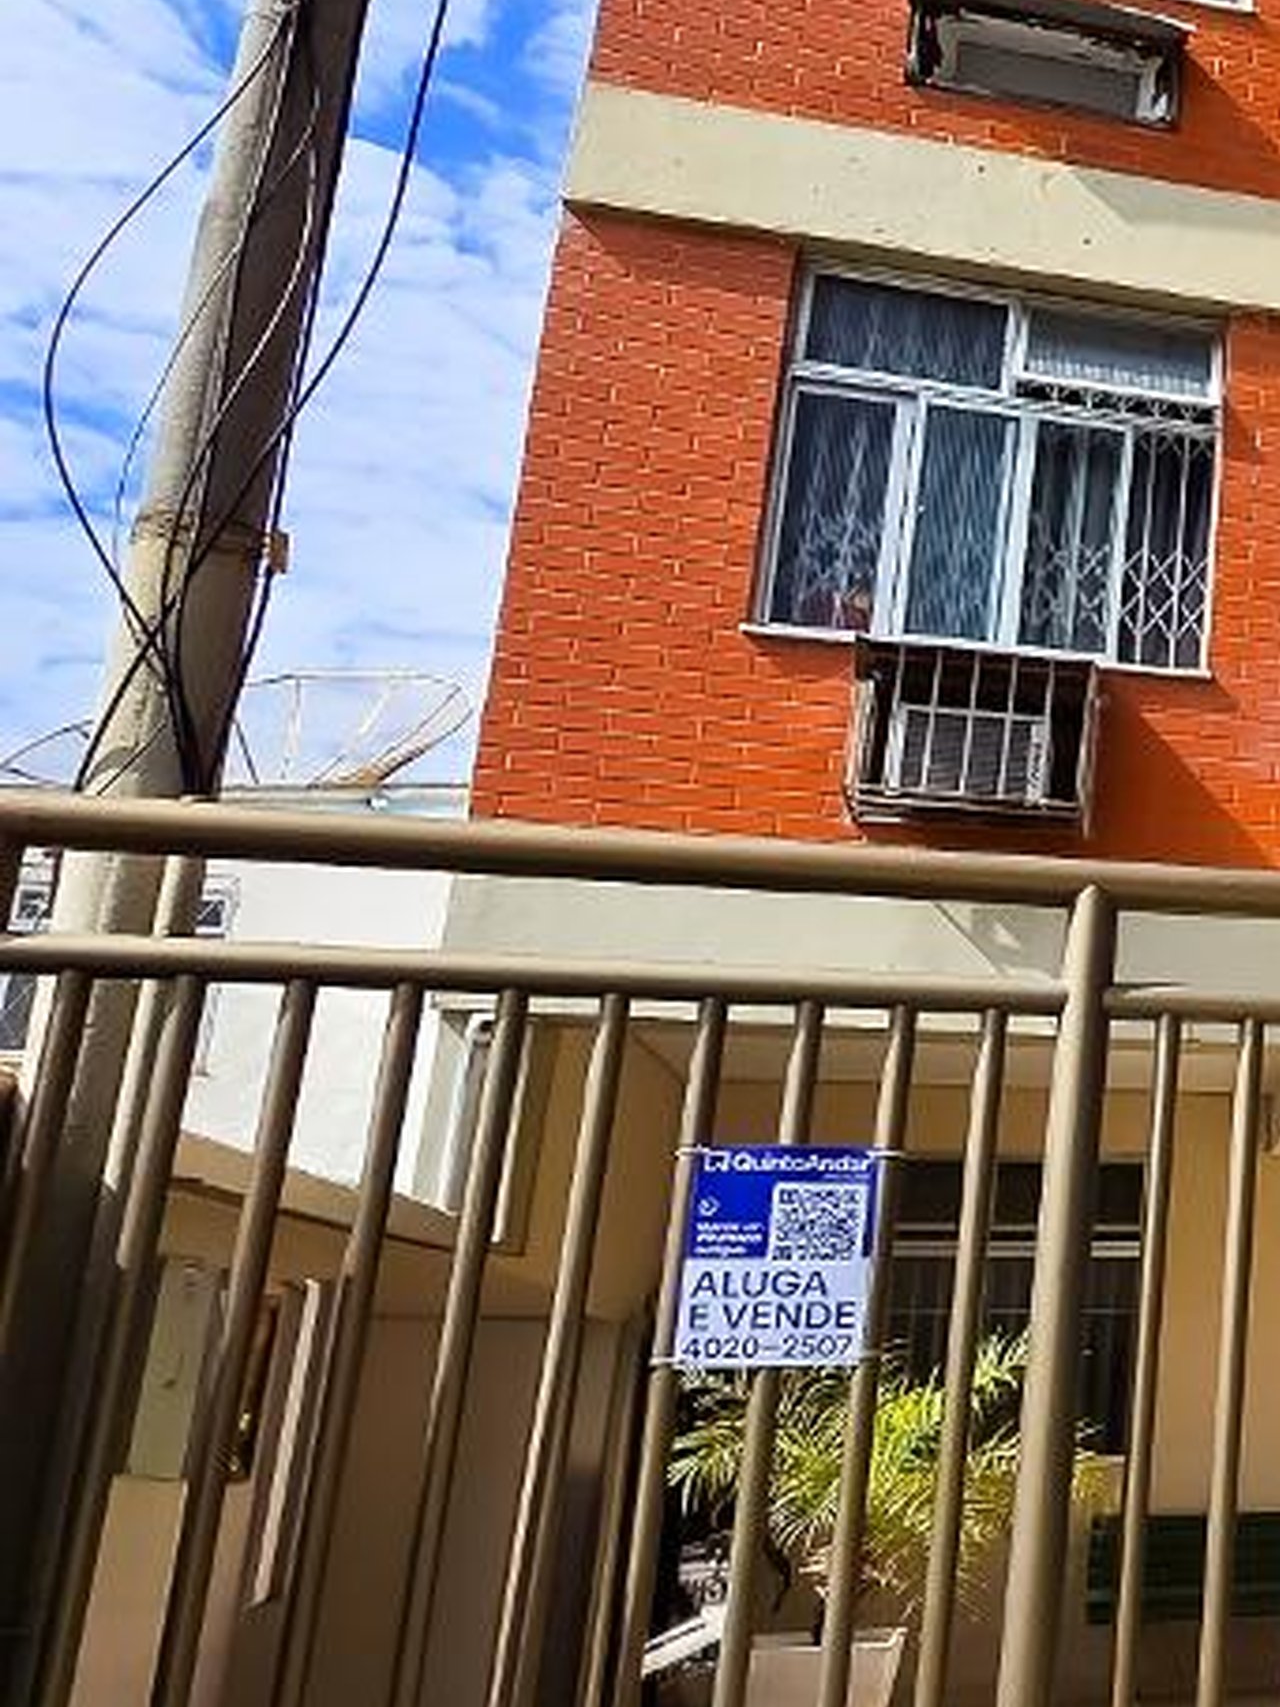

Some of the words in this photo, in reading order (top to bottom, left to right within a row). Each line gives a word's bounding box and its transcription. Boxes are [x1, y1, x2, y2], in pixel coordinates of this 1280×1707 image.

[732, 1150, 871, 1172] QuintoAndar
[689, 1270, 829, 1298] ALUGA
[688, 1303, 710, 1331] E
[722, 1300, 857, 1330] VENDE
[682, 1334, 854, 1359] 4020-2507
